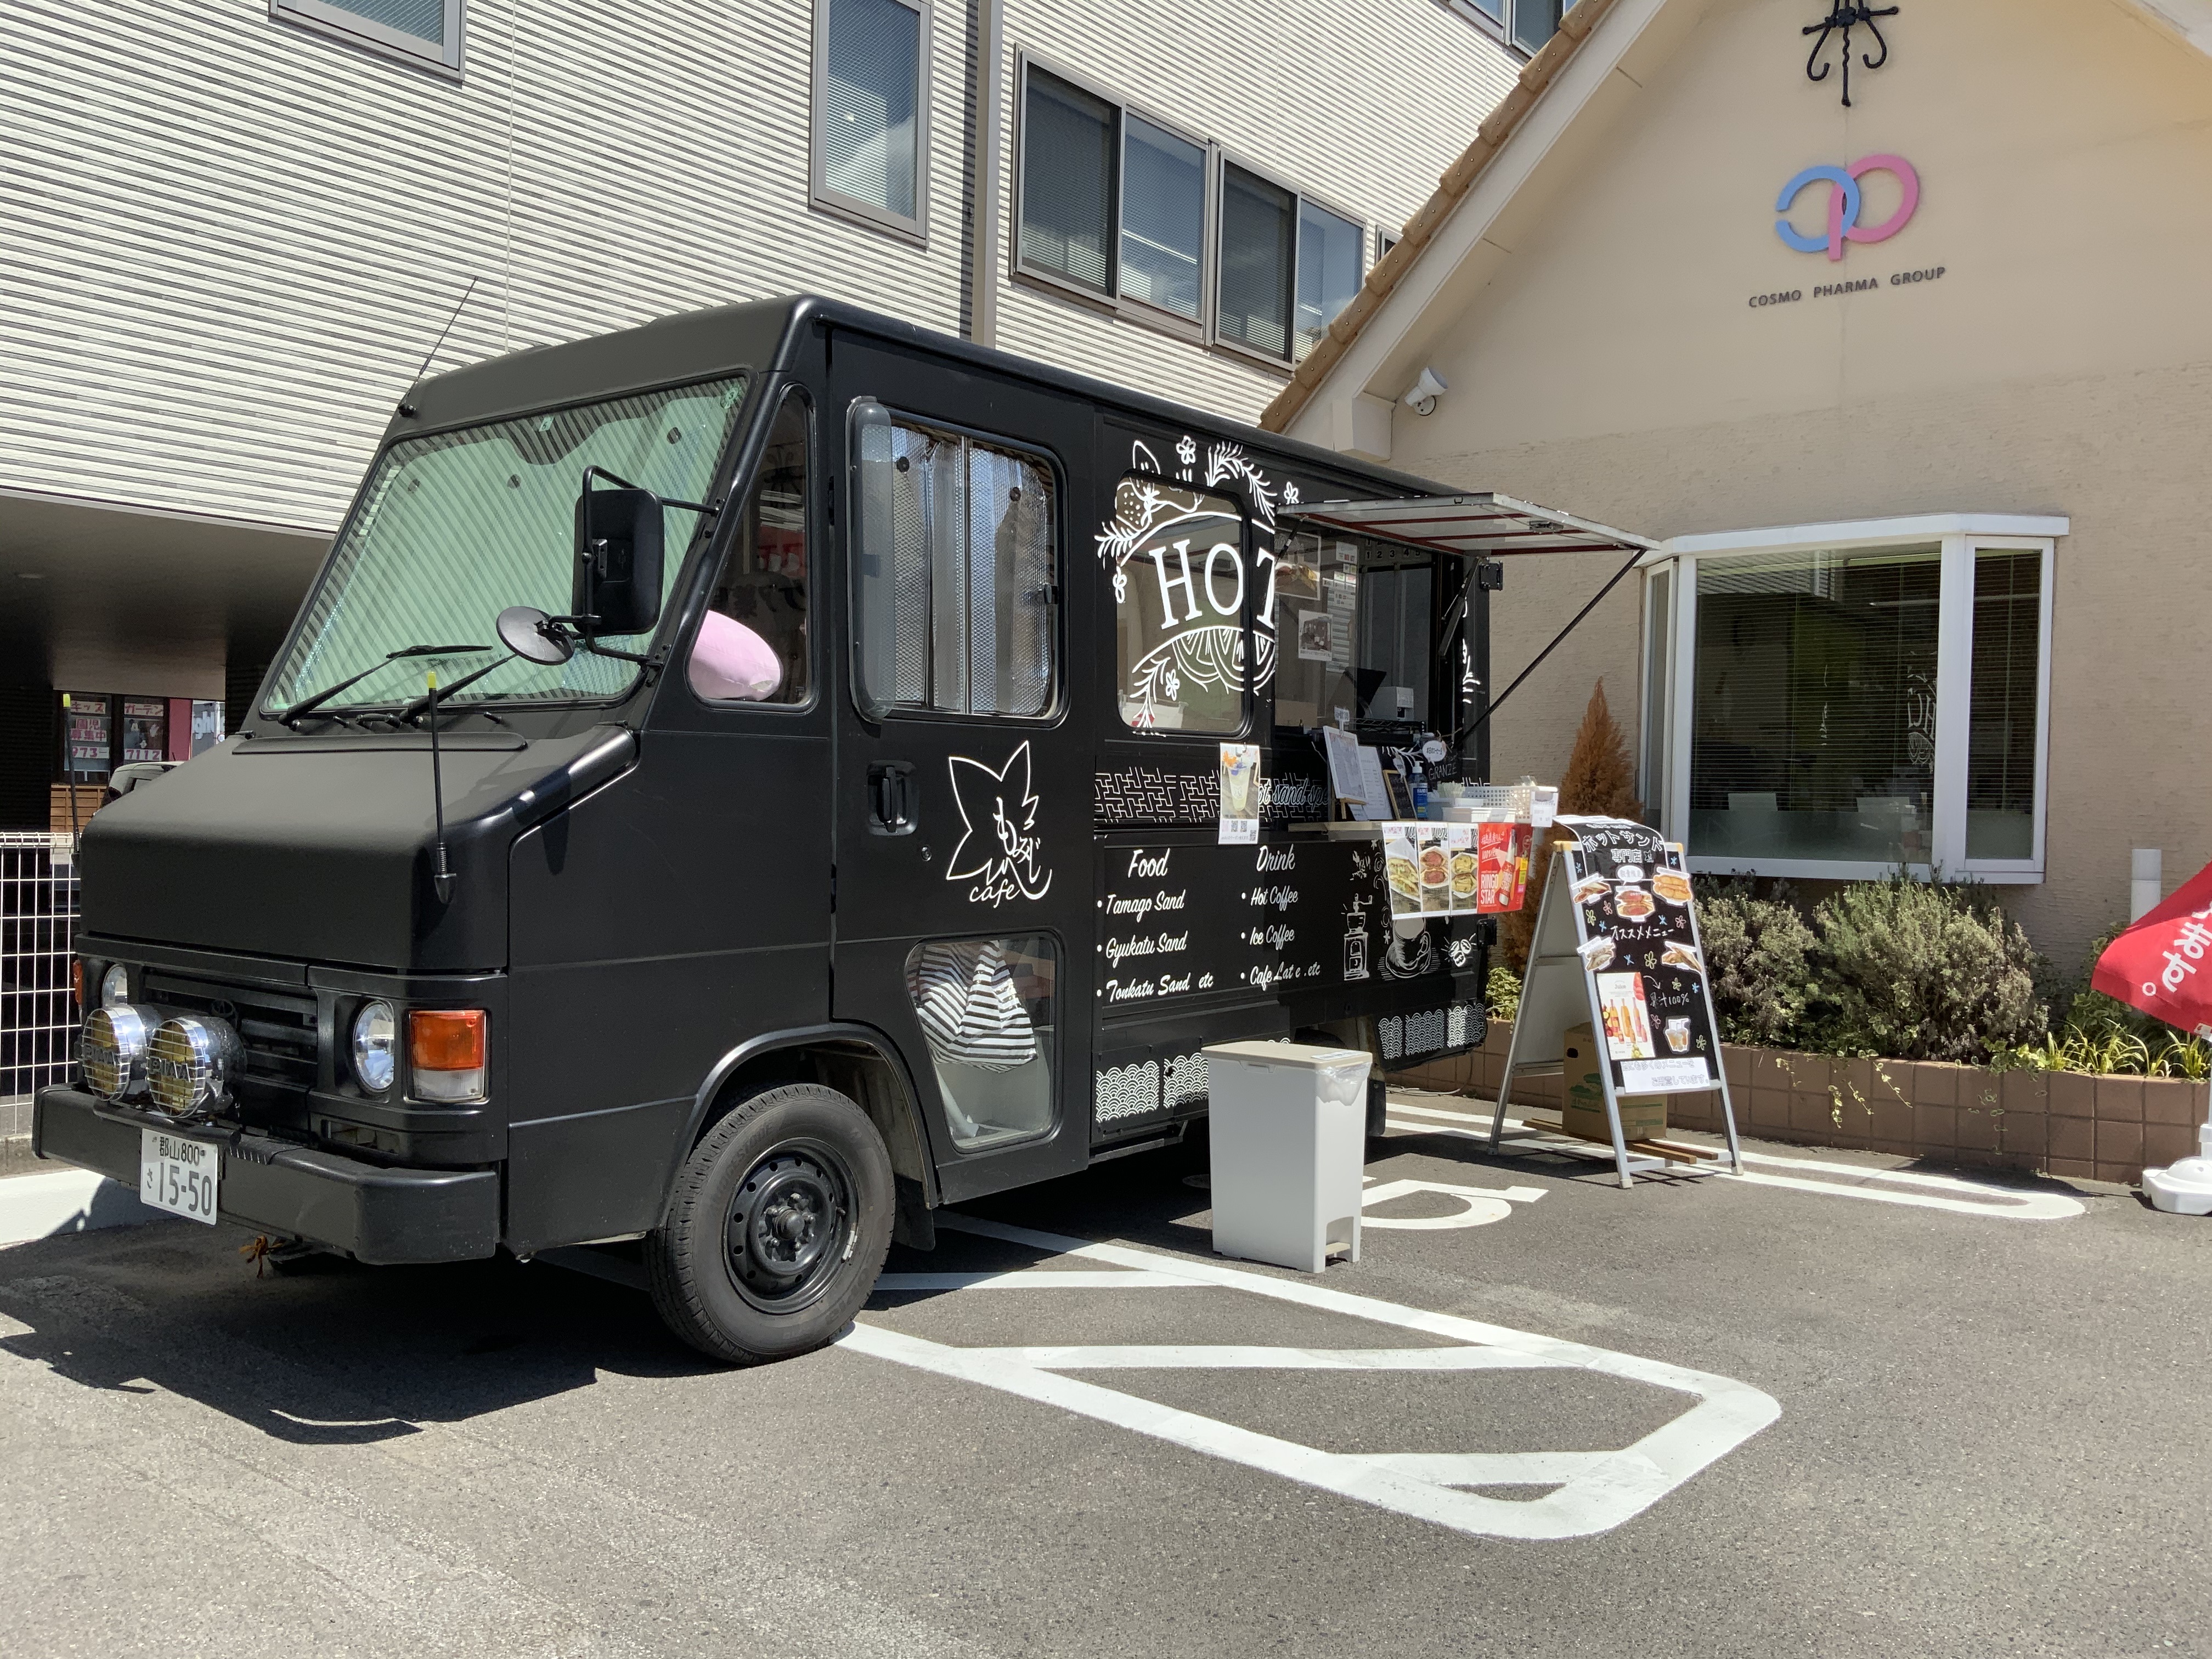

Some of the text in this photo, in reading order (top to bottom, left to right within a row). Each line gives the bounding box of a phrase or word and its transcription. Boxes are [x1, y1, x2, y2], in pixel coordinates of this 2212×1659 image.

[1748, 267, 1946, 308] COSMO PHARMA GROUP
[125, 704, 163, 715] ガーデン
[126, 749, 160, 760] 7112
[1128, 848, 1170, 878] Food
[1256, 843, 1295, 872] Drink
[1611, 849, 1642, 864] 専門店
[969, 879, 1020, 909] cafe
[1481, 874, 1499, 889] RINGO
[1106, 889, 1186, 923] Tamago Sand
[1250, 885, 1299, 911] Hot Coffee
[1480, 889, 1495, 905] STAR
[1249, 923, 1295, 951] Ice Coffee
[1610, 926, 1674, 940] オススメメニュー
[1105, 930, 1188, 969] Gyukatu Sand
[1106, 972, 1214, 1003] Tonkatu Sand etc
[1250, 964, 1272, 991] Cafe
[159, 1136, 200, 1166] 郡山800
[147, 1162, 212, 1216] さ 15-50
